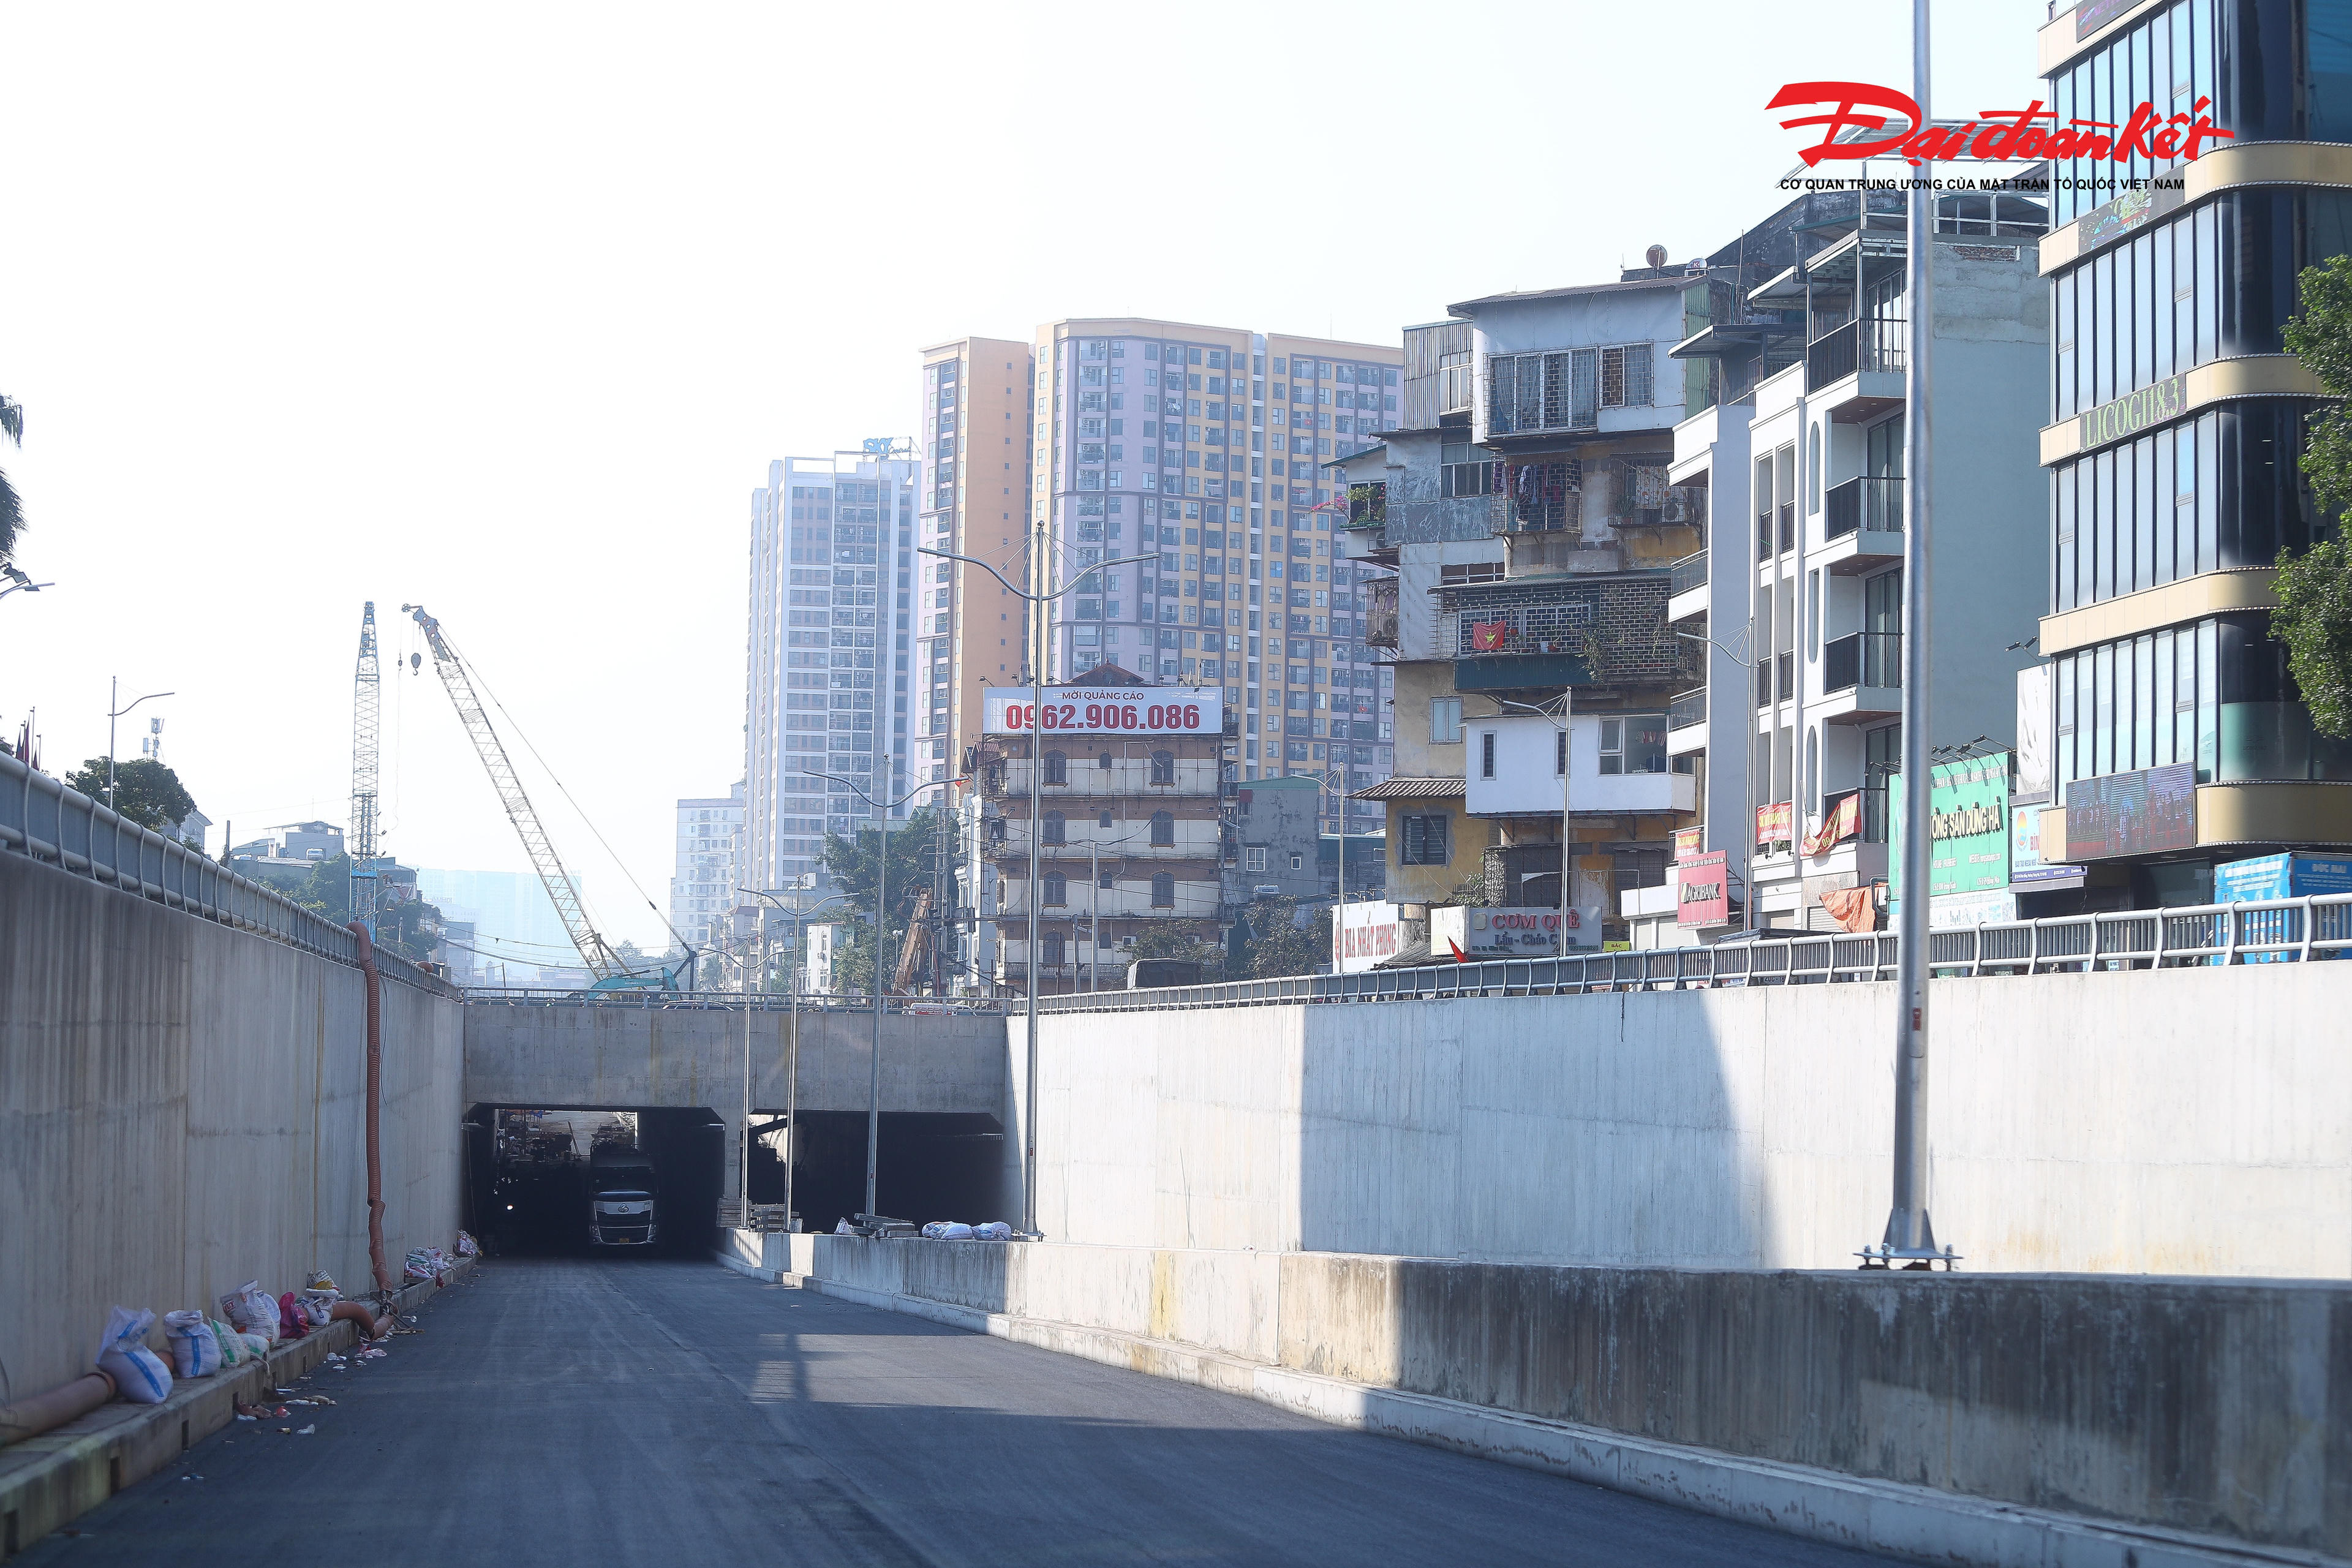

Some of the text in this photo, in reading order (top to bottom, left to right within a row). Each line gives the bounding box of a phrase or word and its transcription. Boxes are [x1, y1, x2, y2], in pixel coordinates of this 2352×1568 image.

[863, 437, 894, 454] SKY
[1062, 689, 1144, 701] MỜI QUẢNG CÁO
[1006, 704, 1200, 729] 0962.906.086
[1930, 807, 1948, 839] ÔNG
[1687, 882, 1721, 901] AGRIBANK
[1491, 913, 1537, 929] CƠM
[1345, 911, 1396, 958] BIA NHẤT PHONG
